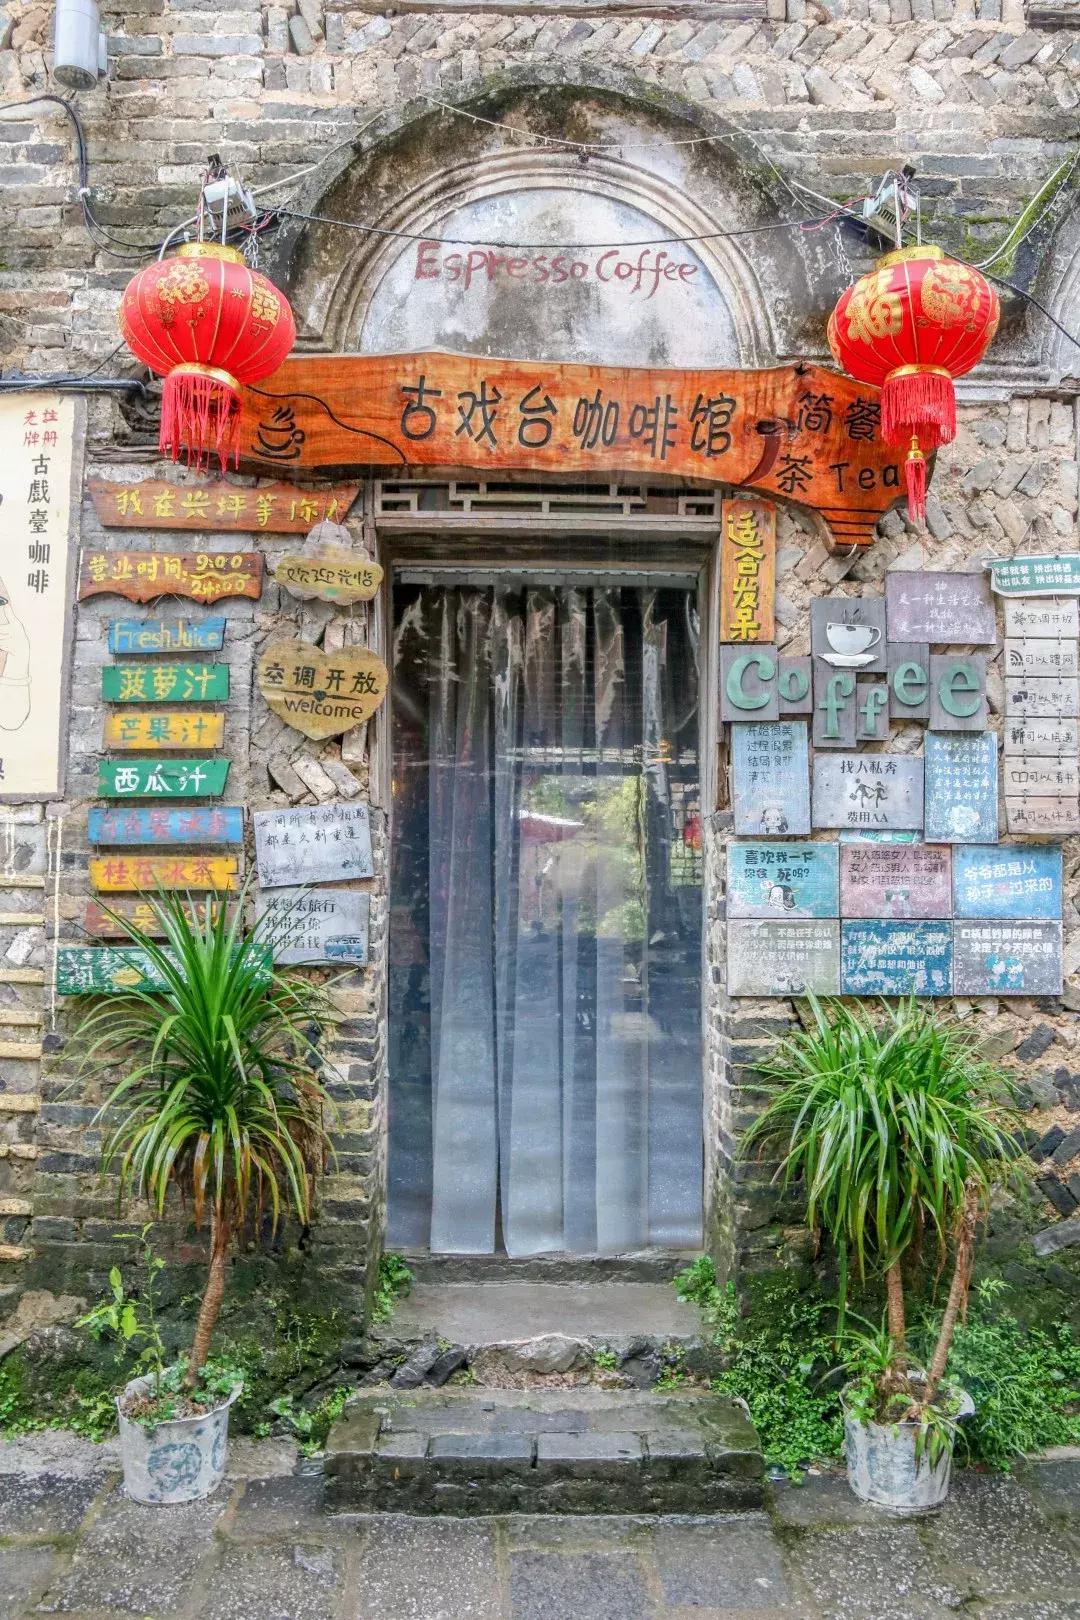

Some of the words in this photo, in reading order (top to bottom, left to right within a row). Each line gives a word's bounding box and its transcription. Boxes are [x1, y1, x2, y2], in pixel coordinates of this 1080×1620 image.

[414, 241, 586, 292] Espresso
[595, 247, 699, 301] Coffee
[400, 375, 738, 460] 古戏台咖啡馆
[796, 391, 881, 442] 简餐
[775, 454, 813, 494] 茶
[830, 461, 902, 493] Tea
[27, 454, 51, 594] 古戲臺咖啡
[195, 554, 245, 572] 9:00
[287, 567, 373, 587] 欢迎光临
[727, 510, 765, 641] 适合发呆
[191, 579, 247, 597] 24:00
[113, 621, 171, 649] Fresh
[175, 621, 220, 649] Juice
[119, 667, 217, 700] 菠萝汁
[263, 662, 380, 696] 空调开放
[726, 653, 984, 739] Coffee
[119, 716, 208, 743] 芒果汁
[114, 763, 207, 793] 西瓜汁
[840, 760, 898, 774] 找人私奔
[744, 849, 814, 865] 喜欢我一下
[265, 897, 336, 913] 我想去旅行
